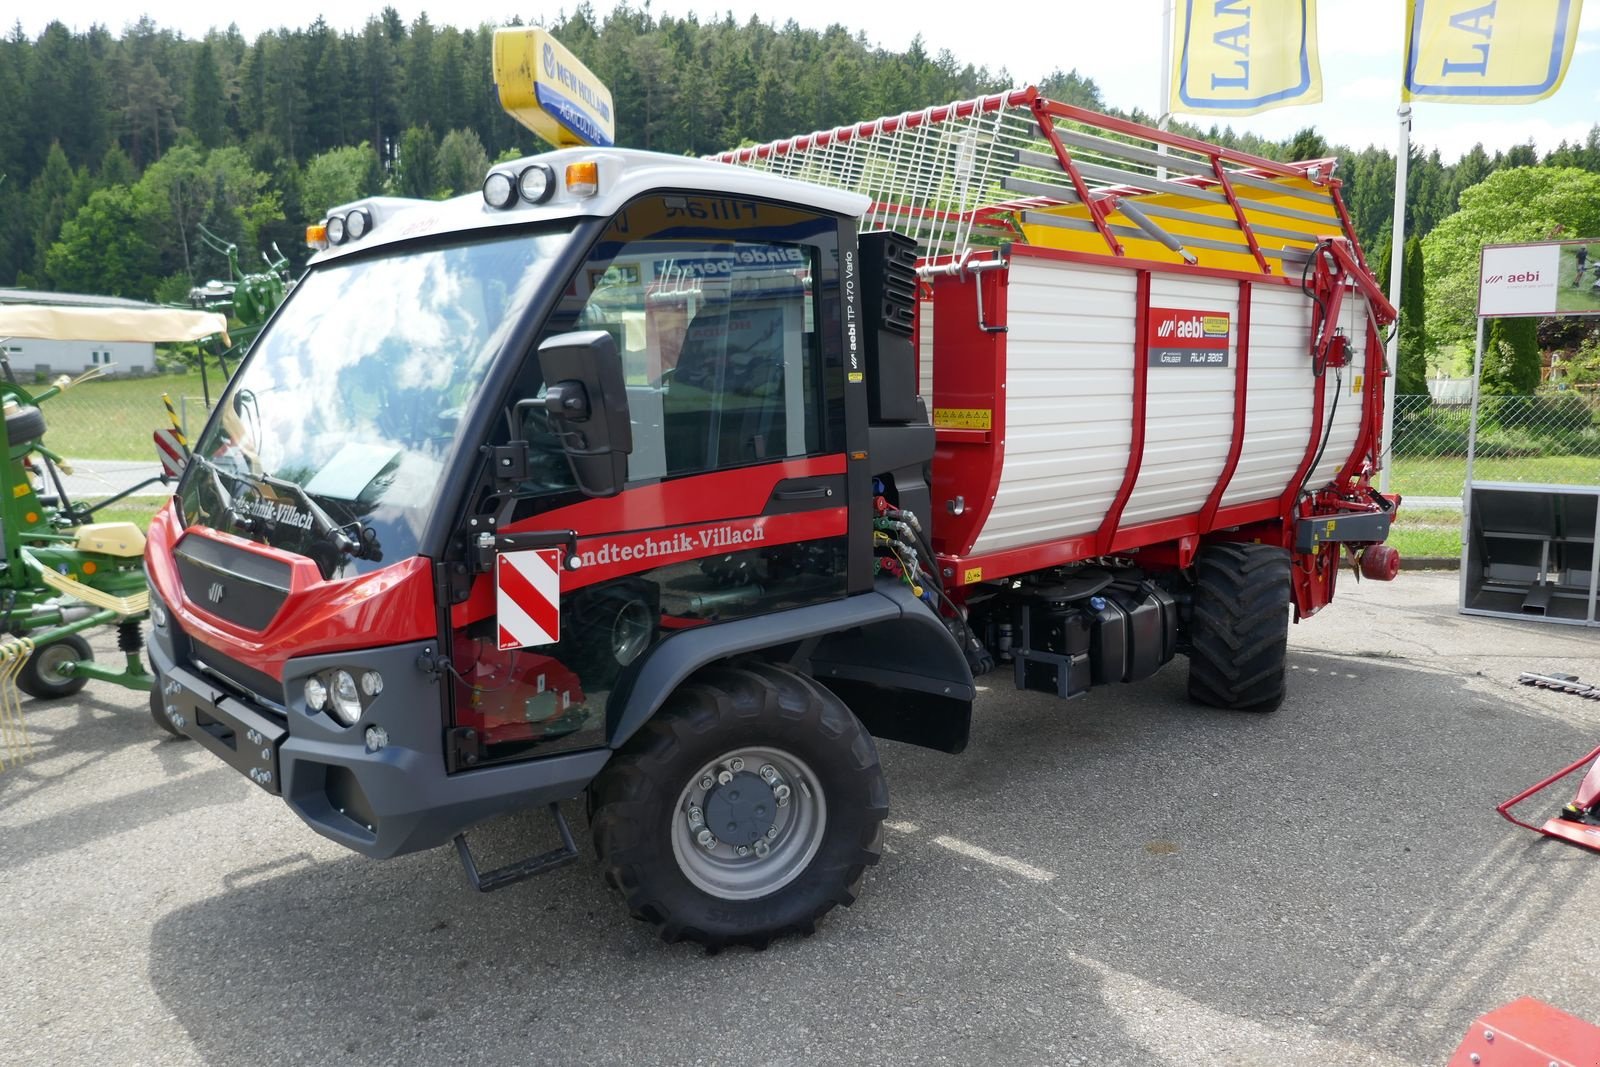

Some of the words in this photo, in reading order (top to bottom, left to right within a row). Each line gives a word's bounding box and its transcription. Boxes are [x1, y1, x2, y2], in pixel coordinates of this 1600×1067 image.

[1441, 0, 1497, 77] LA
[556, 61, 577, 94] NEW
[578, 79, 610, 123] HOLLAND
[559, 101, 601, 145] AGRICULTURE
[845, 251, 854, 279] Vario
[1507, 271, 1540, 283] aebi
[846, 280, 855, 303] 470
[847, 305, 855, 321] TP
[1177, 316, 1204, 338] aebi
[848, 323, 857, 351] aebi
[560, 524, 765, 571] ndtechnik-Villach
